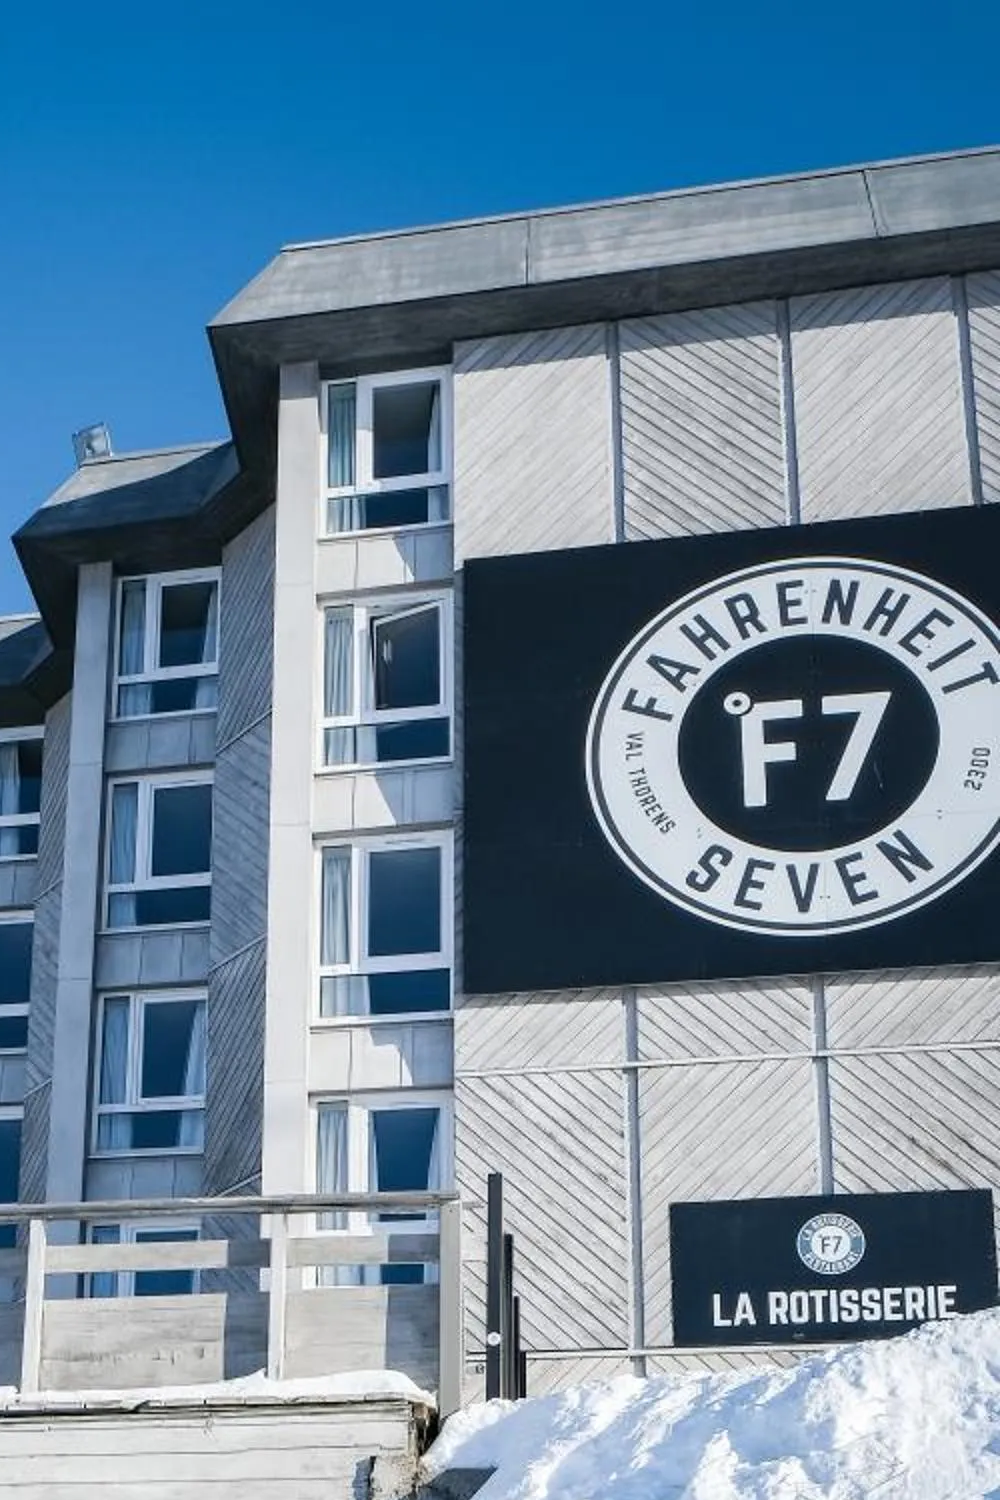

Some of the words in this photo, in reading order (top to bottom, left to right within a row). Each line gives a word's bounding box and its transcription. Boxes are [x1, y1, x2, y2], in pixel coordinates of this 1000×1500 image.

[621, 579, 999, 723] FAHRENHEIT
[625, 731, 645, 761] VAL
[963, 747, 991, 791] 2300
[628, 767, 676, 834] THORENS
[686, 830, 935, 913] SEVEN
[712, 1292, 757, 1328] LA
[767, 1285, 957, 1326] ROTISSERIE
